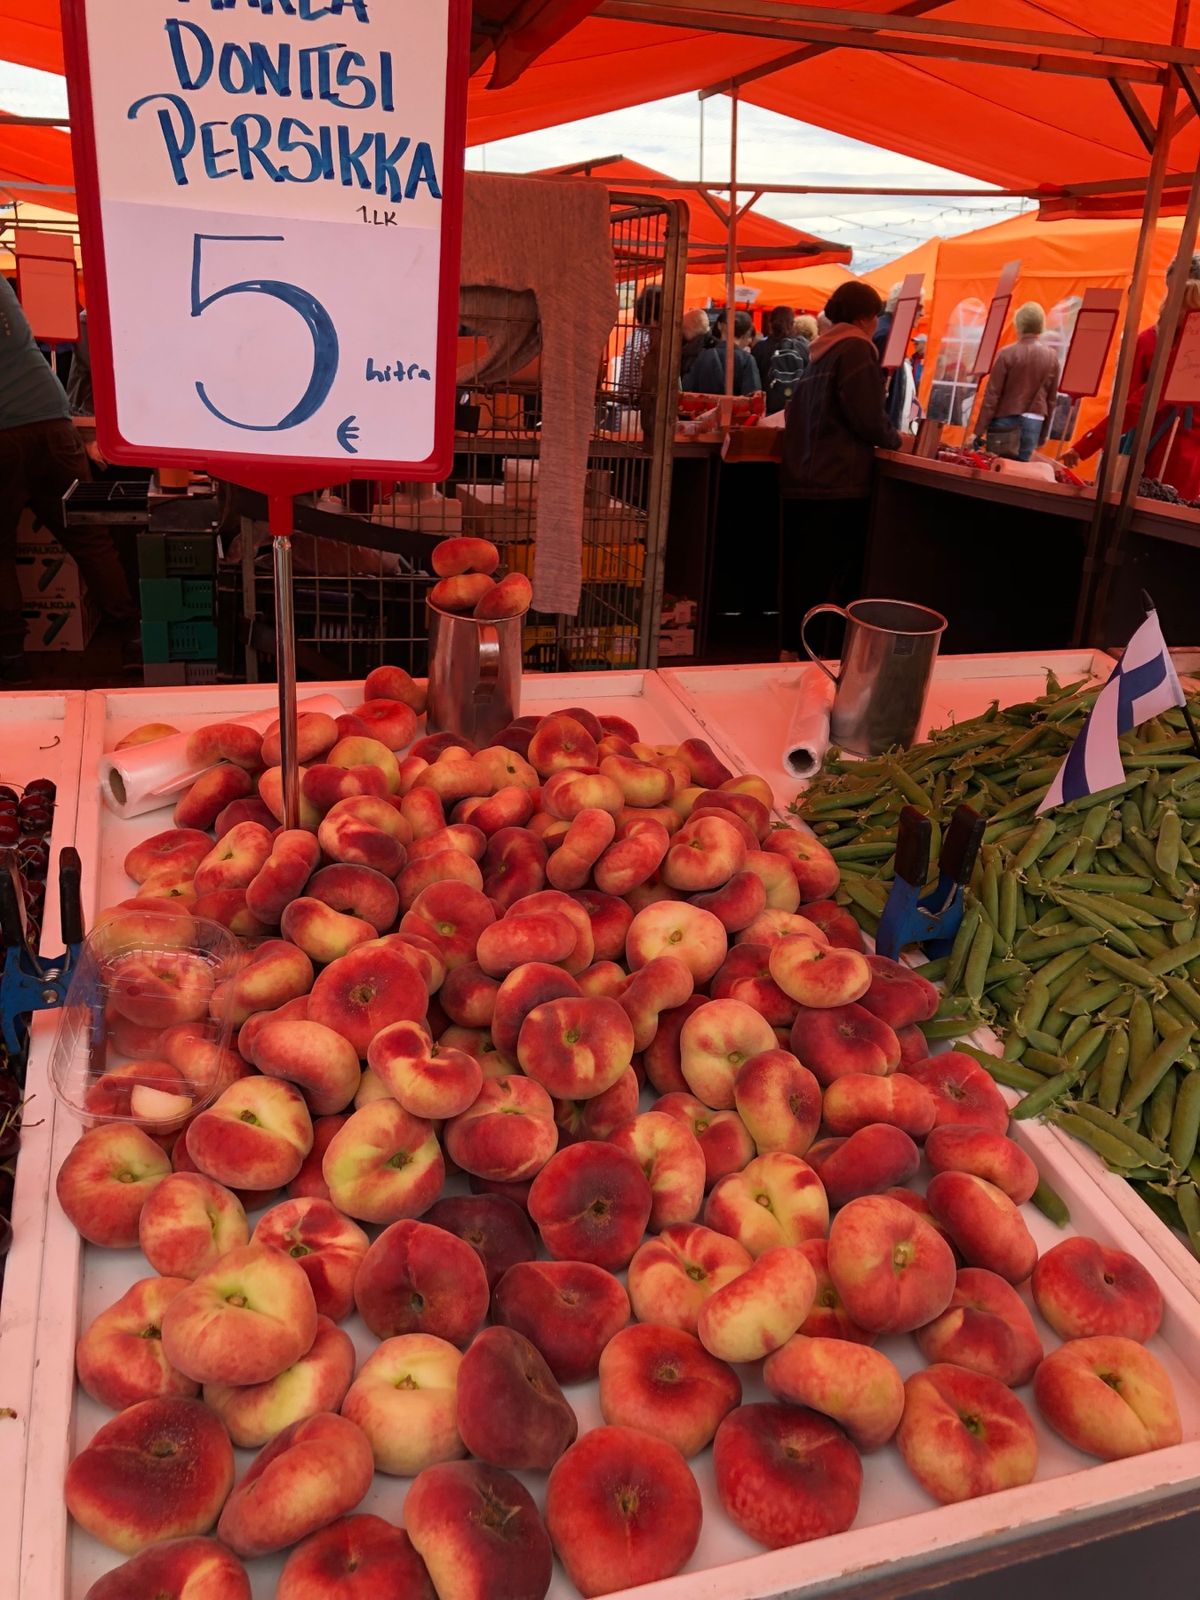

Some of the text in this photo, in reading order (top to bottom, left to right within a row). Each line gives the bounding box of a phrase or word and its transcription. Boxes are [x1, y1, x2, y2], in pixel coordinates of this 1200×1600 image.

[127, 93, 443, 203] PERSIKKA
[190, 233, 339, 431] 5
[336, 415, 360, 454] €
